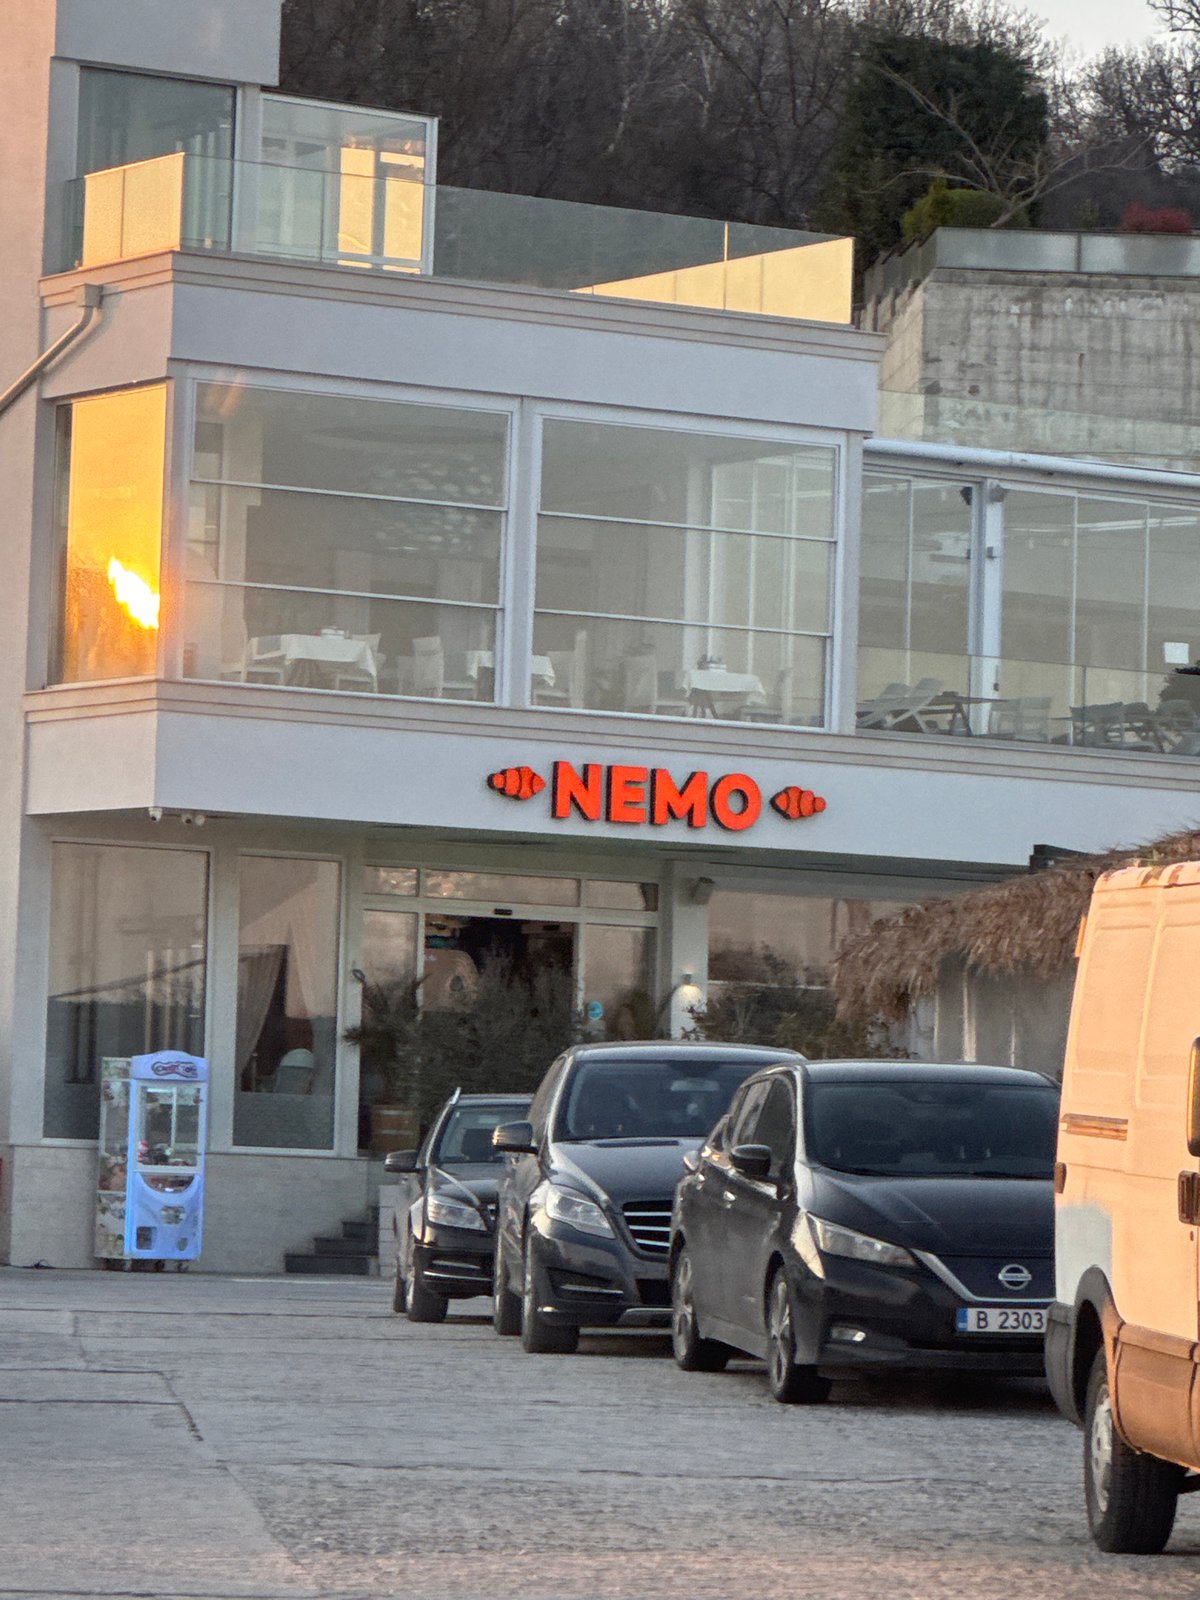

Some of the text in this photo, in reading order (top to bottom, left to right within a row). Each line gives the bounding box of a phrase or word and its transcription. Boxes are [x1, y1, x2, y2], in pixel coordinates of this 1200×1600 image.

[552, 760, 762, 831] NEMO
[976, 1311, 1044, 1330] B 2303
